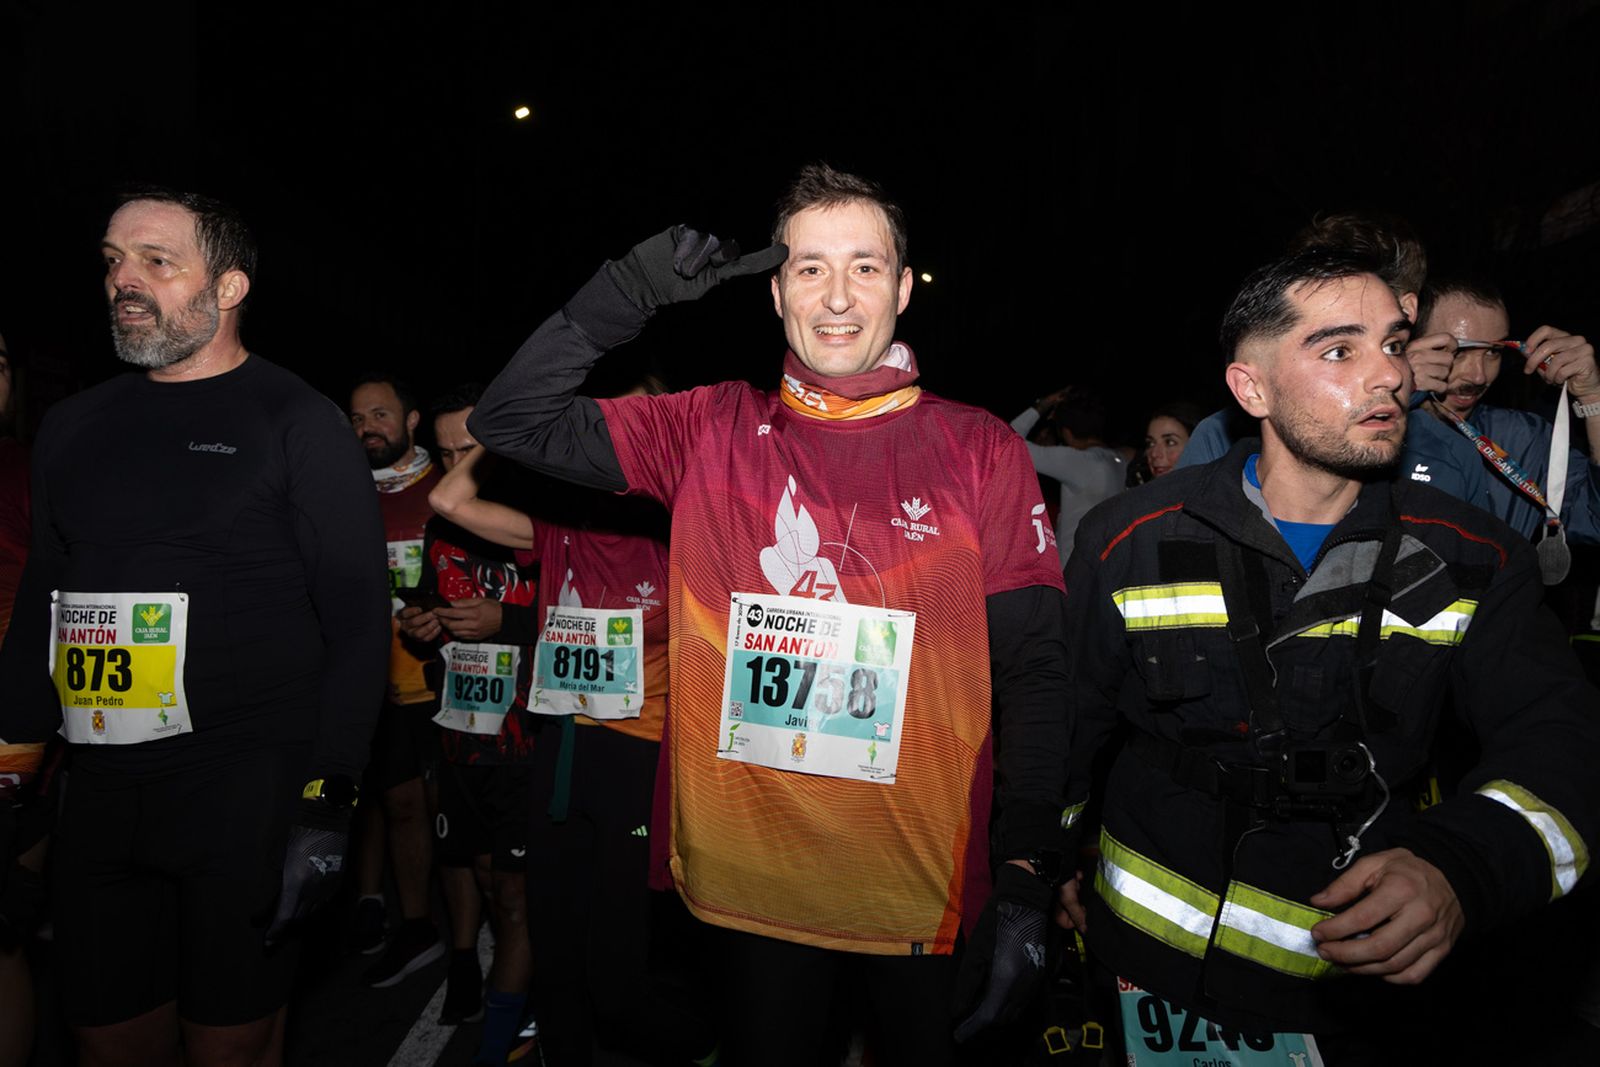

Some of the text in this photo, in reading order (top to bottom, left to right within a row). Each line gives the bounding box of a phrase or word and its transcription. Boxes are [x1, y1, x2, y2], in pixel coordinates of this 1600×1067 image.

[1484, 446, 1496, 459] DE
[1494, 457, 1514, 475] SAN
[910, 523, 940, 535] RURAL
[99, 611, 117, 624] DE
[747, 608, 763, 621] 43
[555, 619, 596, 632] NOCHE DE
[764, 615, 842, 637] NOCHE DE
[58, 625, 117, 644] AN ANTÓN
[545, 631, 563, 643] SAN
[744, 633, 776, 652] SAN
[67, 647, 132, 692] 873
[553, 646, 615, 682] 8191
[455, 674, 504, 704] 9230
[579, 683, 589, 691] del
[590, 684, 605, 692] Mar
[747, 655, 879, 720] 13758
[73, 696, 124, 706] Juan Pedro
[785, 714, 814, 728] Javi
